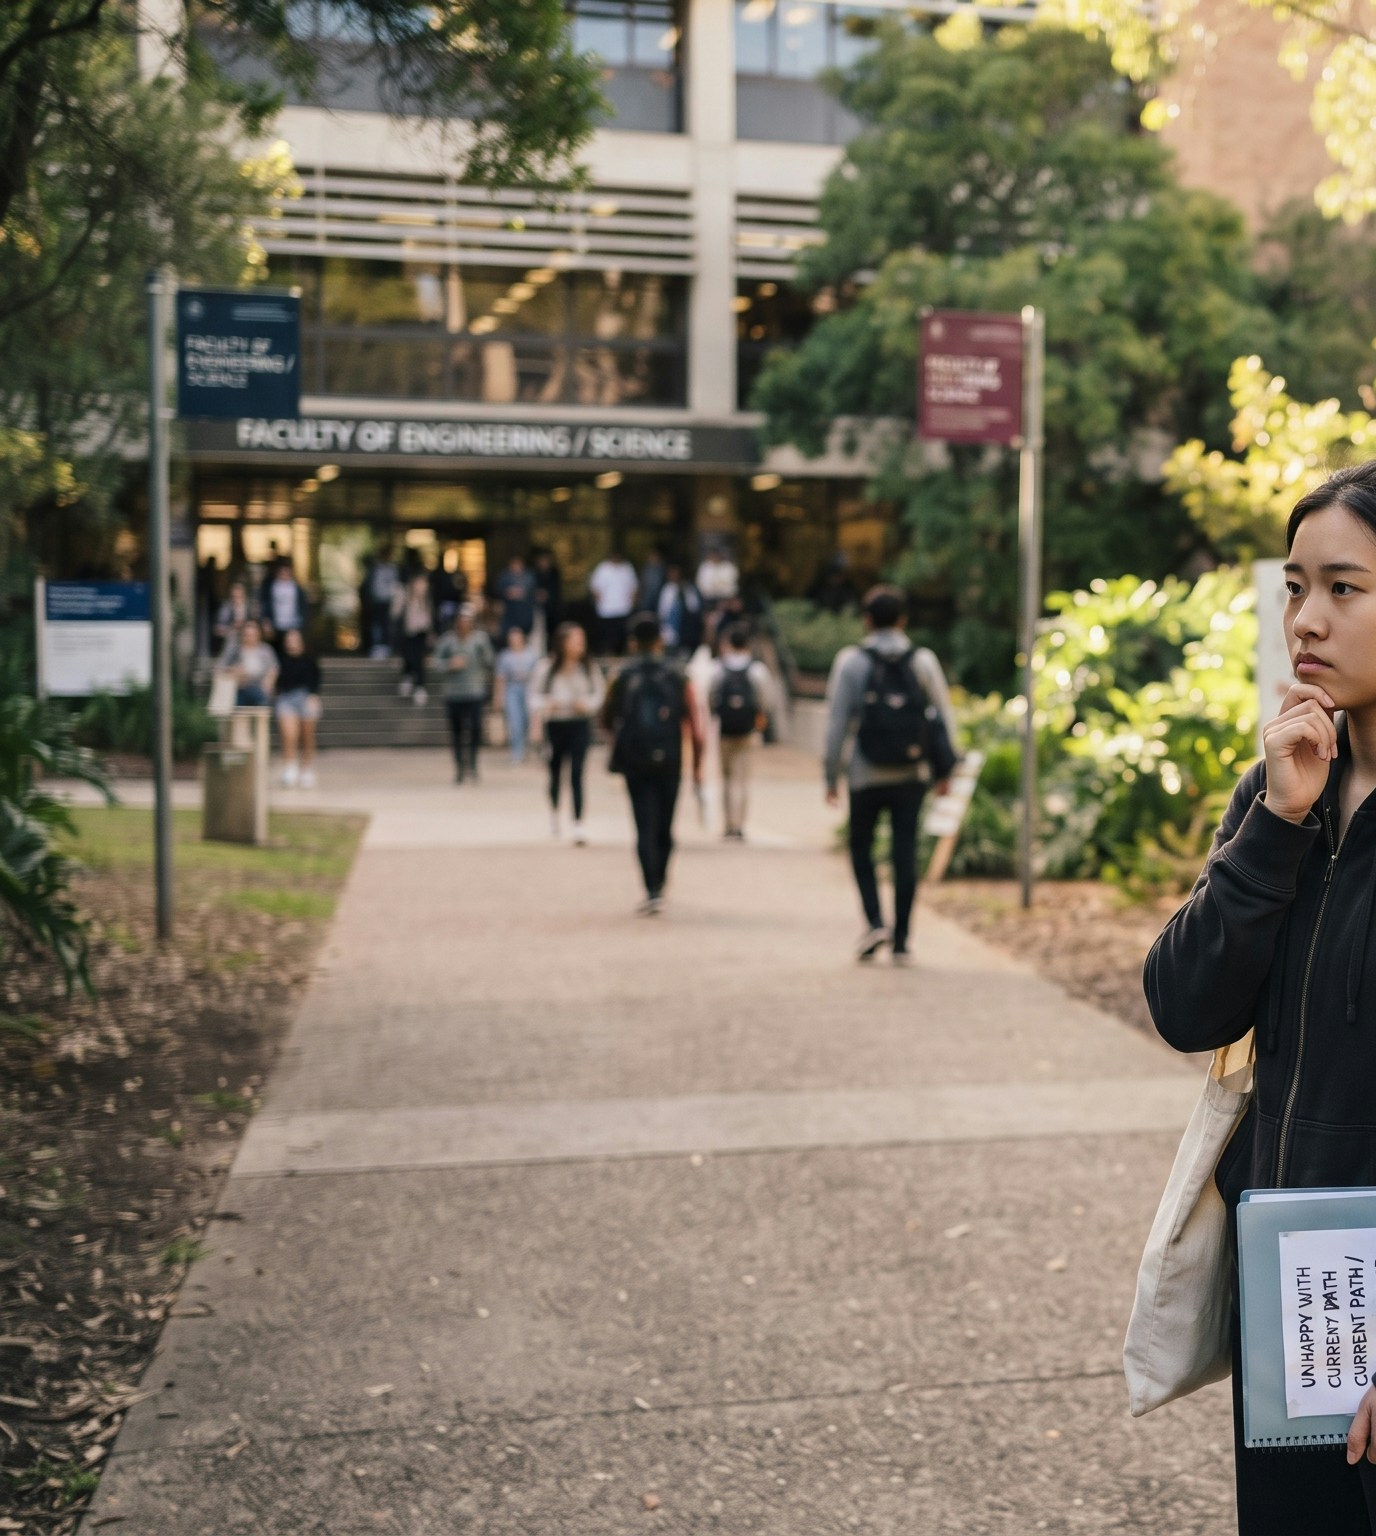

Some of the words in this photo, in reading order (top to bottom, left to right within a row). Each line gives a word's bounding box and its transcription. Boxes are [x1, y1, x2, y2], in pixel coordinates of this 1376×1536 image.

[236, 417, 356, 450] FACULTY
[356, 420, 398, 452] OF
[399, 421, 572, 458] ENGINEERING
[571, 426, 589, 458] /
[588, 426, 693, 460] SCIENCE
[1343, 1255, 1364, 1263] /
[1296, 1266, 1313, 1309] WITH
[1347, 1267, 1366, 1308] PATH
[1298, 1313, 1316, 1388] UNHAPPY
[1350, 1313, 1368, 1387] CURRENT
